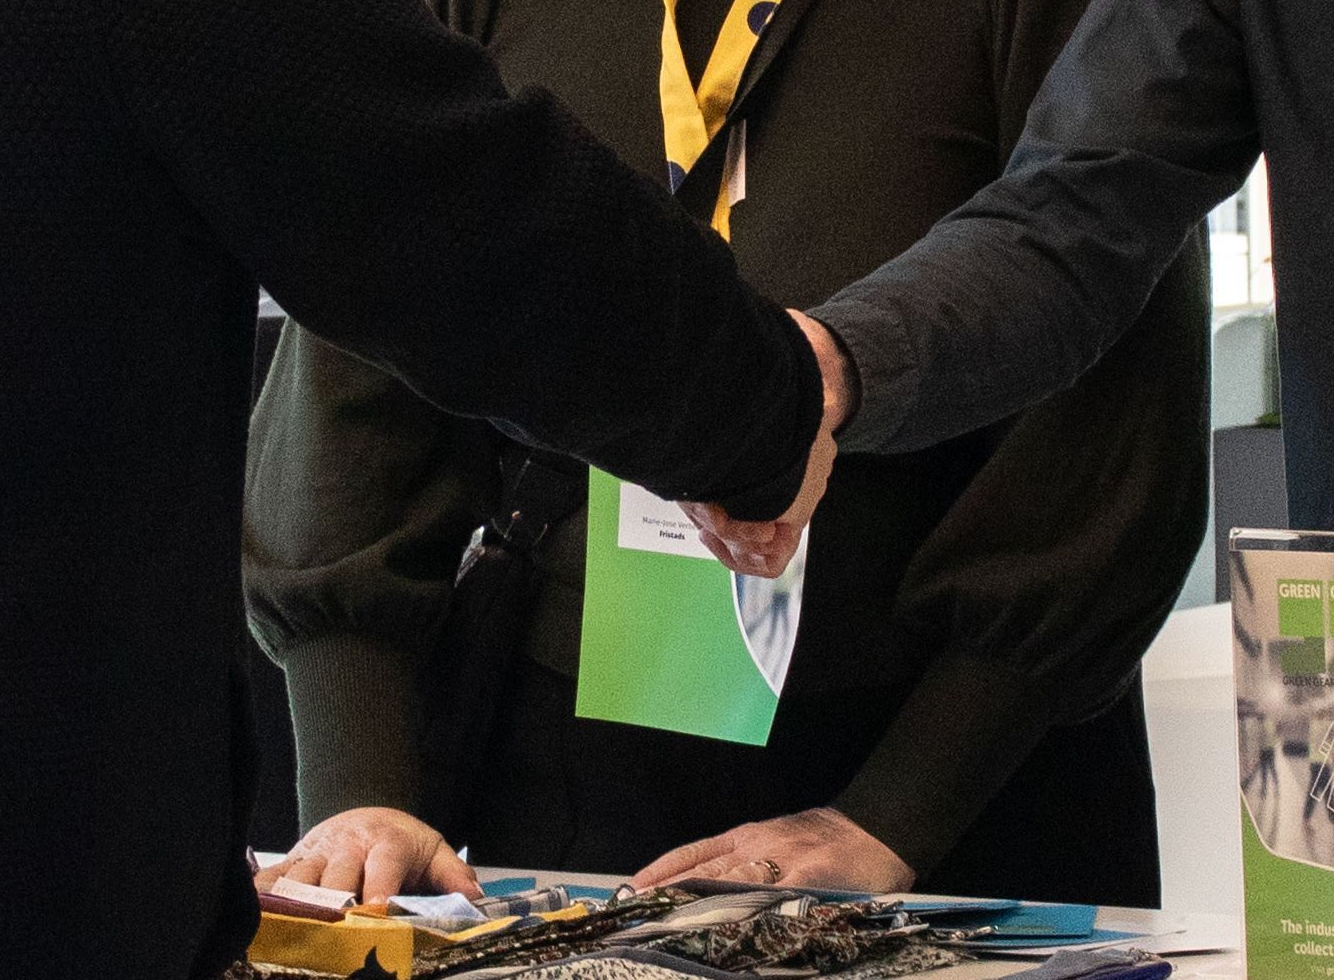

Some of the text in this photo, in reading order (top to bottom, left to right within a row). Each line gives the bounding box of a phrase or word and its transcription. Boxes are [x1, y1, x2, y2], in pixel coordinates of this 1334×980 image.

[659, 530, 686, 540] Fristads
[1279, 583, 1321, 599] GREEN
[1282, 675, 1311, 687] GREEN
[1280, 919, 1303, 935] The
